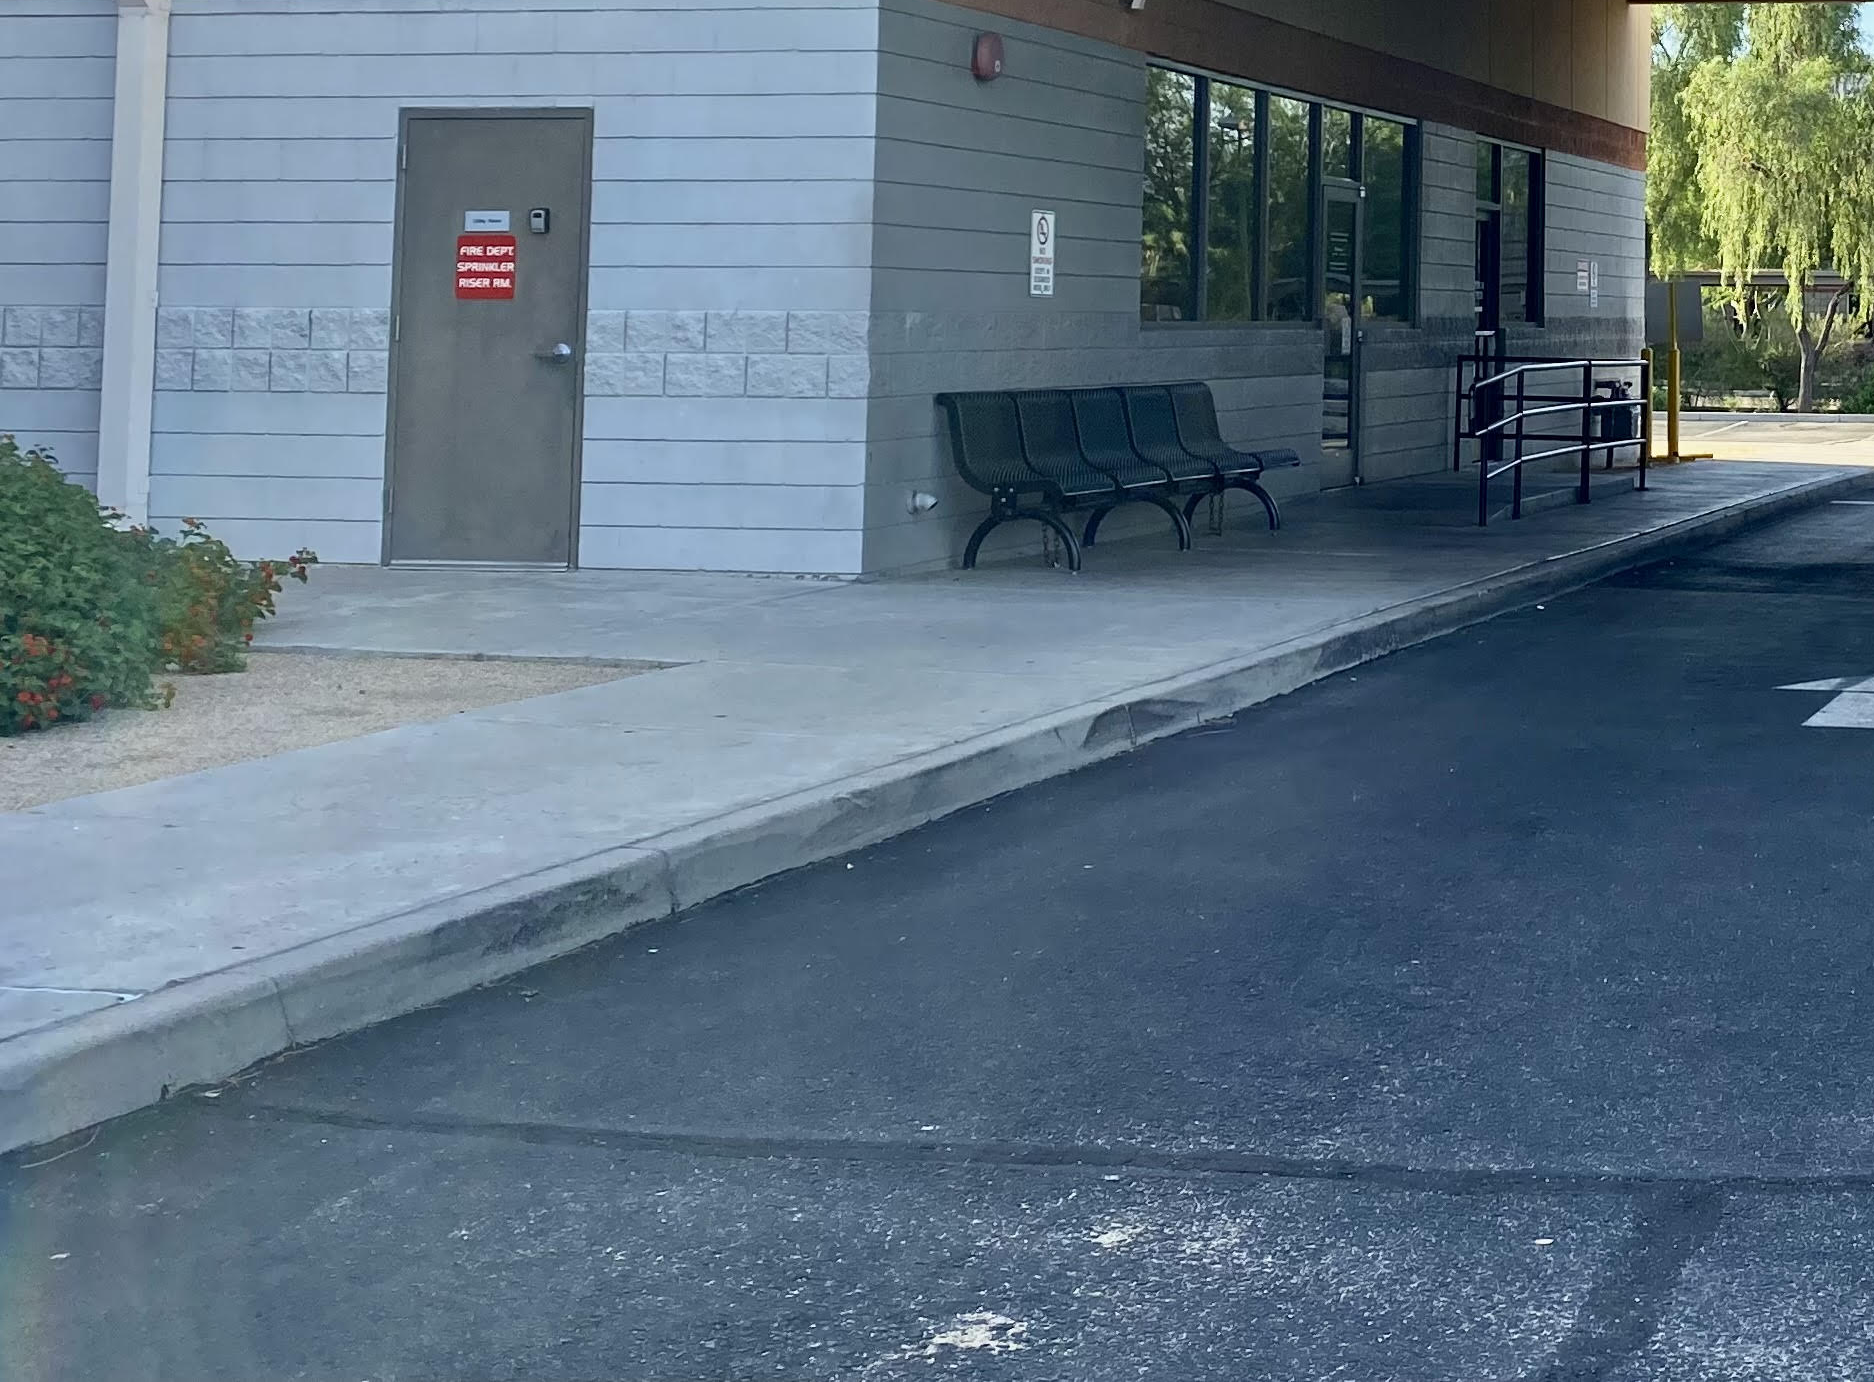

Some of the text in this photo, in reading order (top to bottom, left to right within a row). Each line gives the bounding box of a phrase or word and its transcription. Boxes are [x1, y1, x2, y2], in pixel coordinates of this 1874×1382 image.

[460, 246, 484, 256] FIRE
[457, 262, 515, 272] SPRINKLER
[458, 278, 491, 288] RISER
